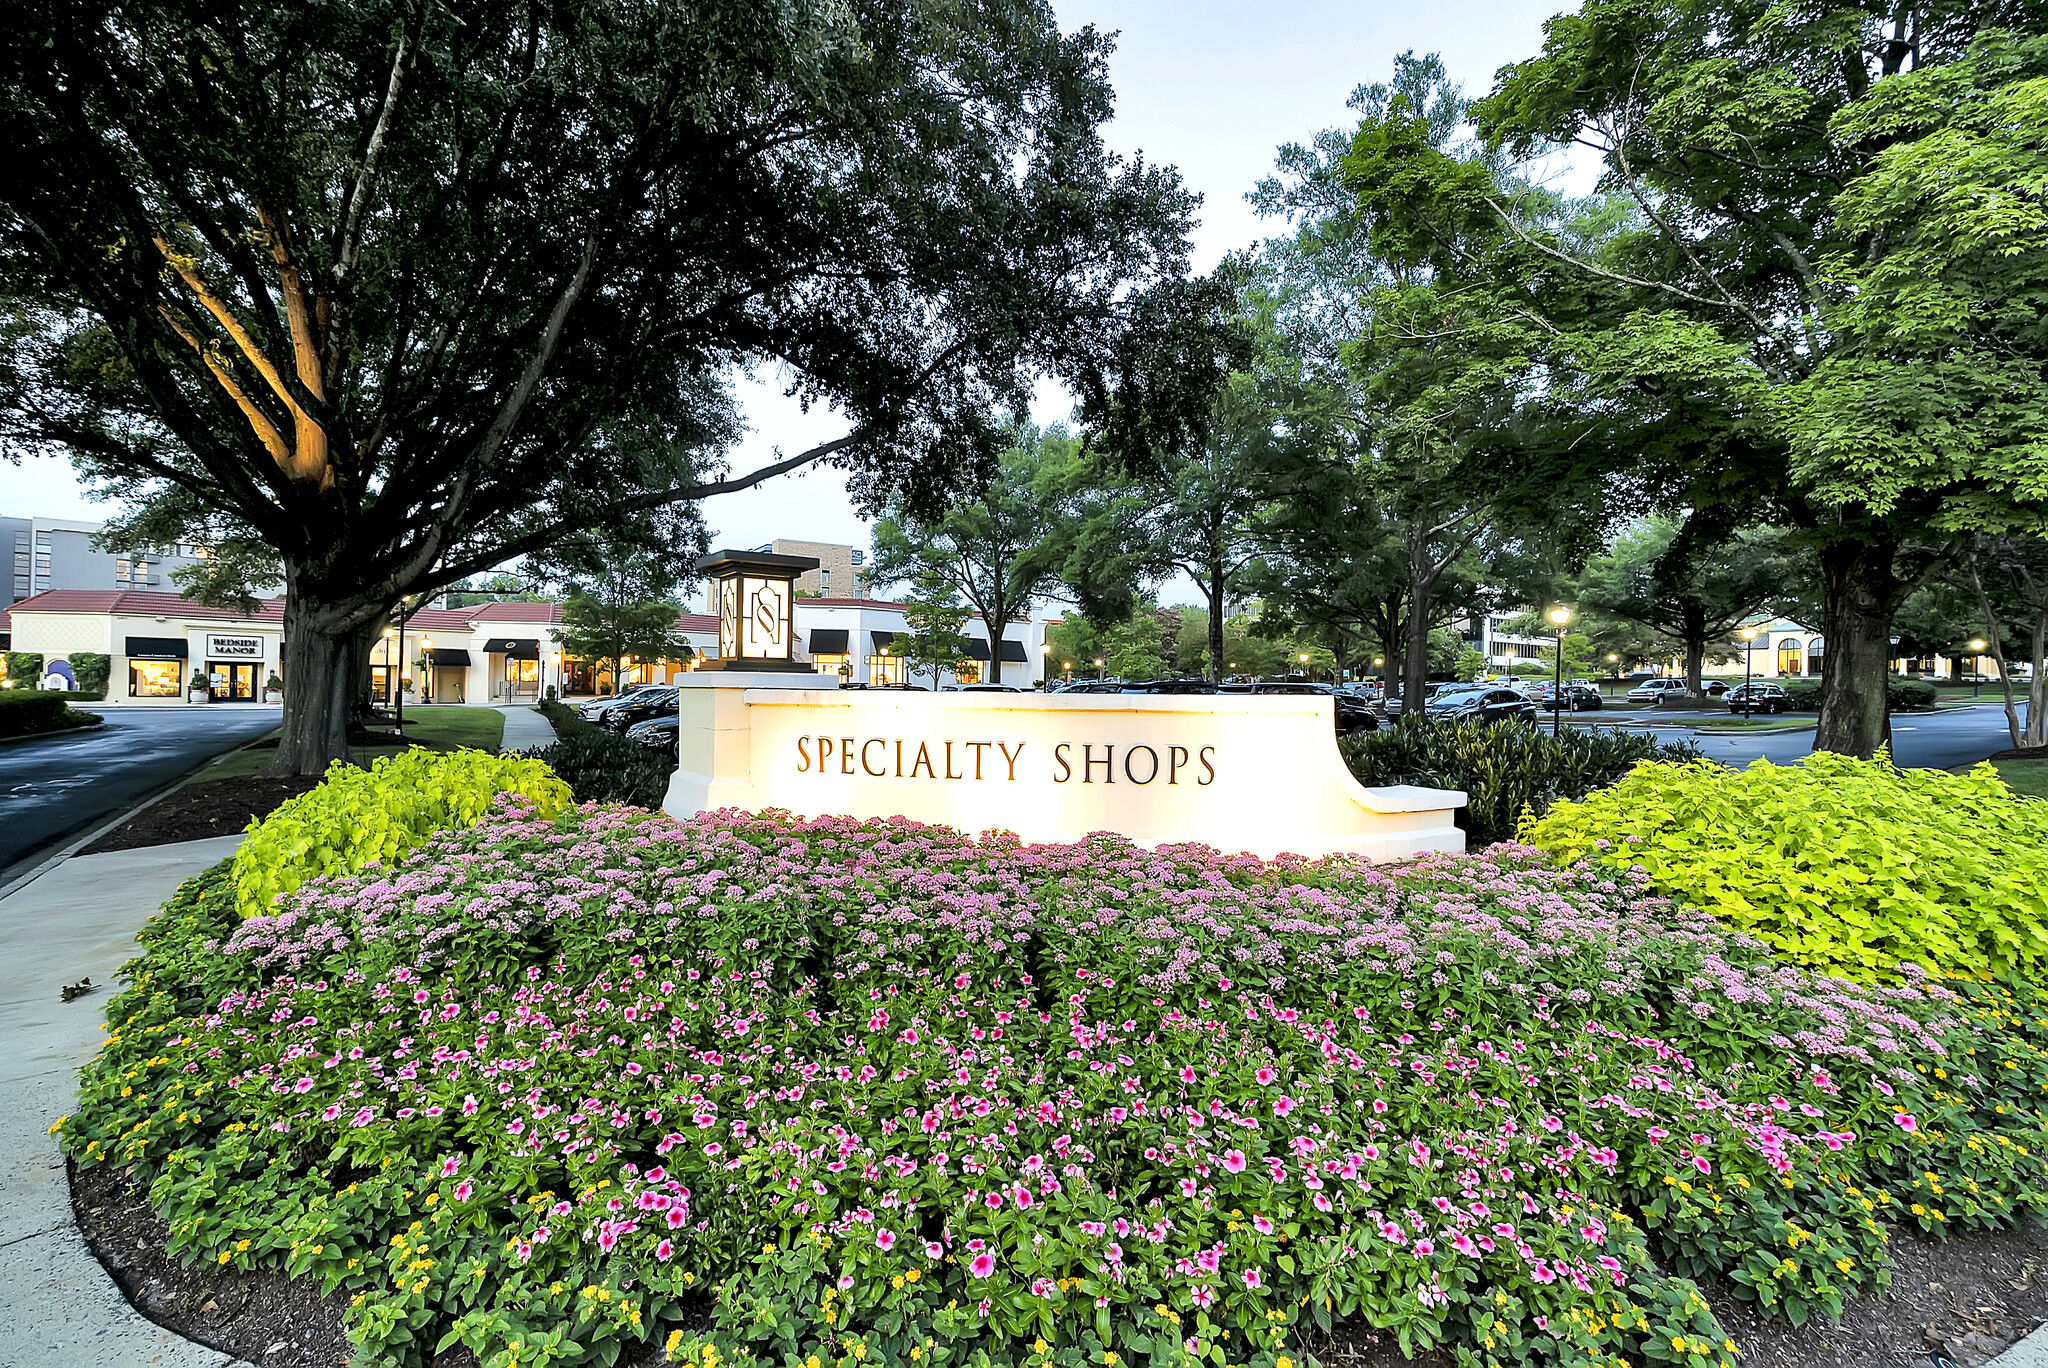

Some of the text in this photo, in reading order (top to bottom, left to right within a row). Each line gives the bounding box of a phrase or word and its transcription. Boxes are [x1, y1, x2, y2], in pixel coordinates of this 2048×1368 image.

[213, 638, 258, 647] BEDSIDE
[215, 646, 256, 654] MANOR
[797, 735, 1216, 786] SPECIALTY SHOPS
